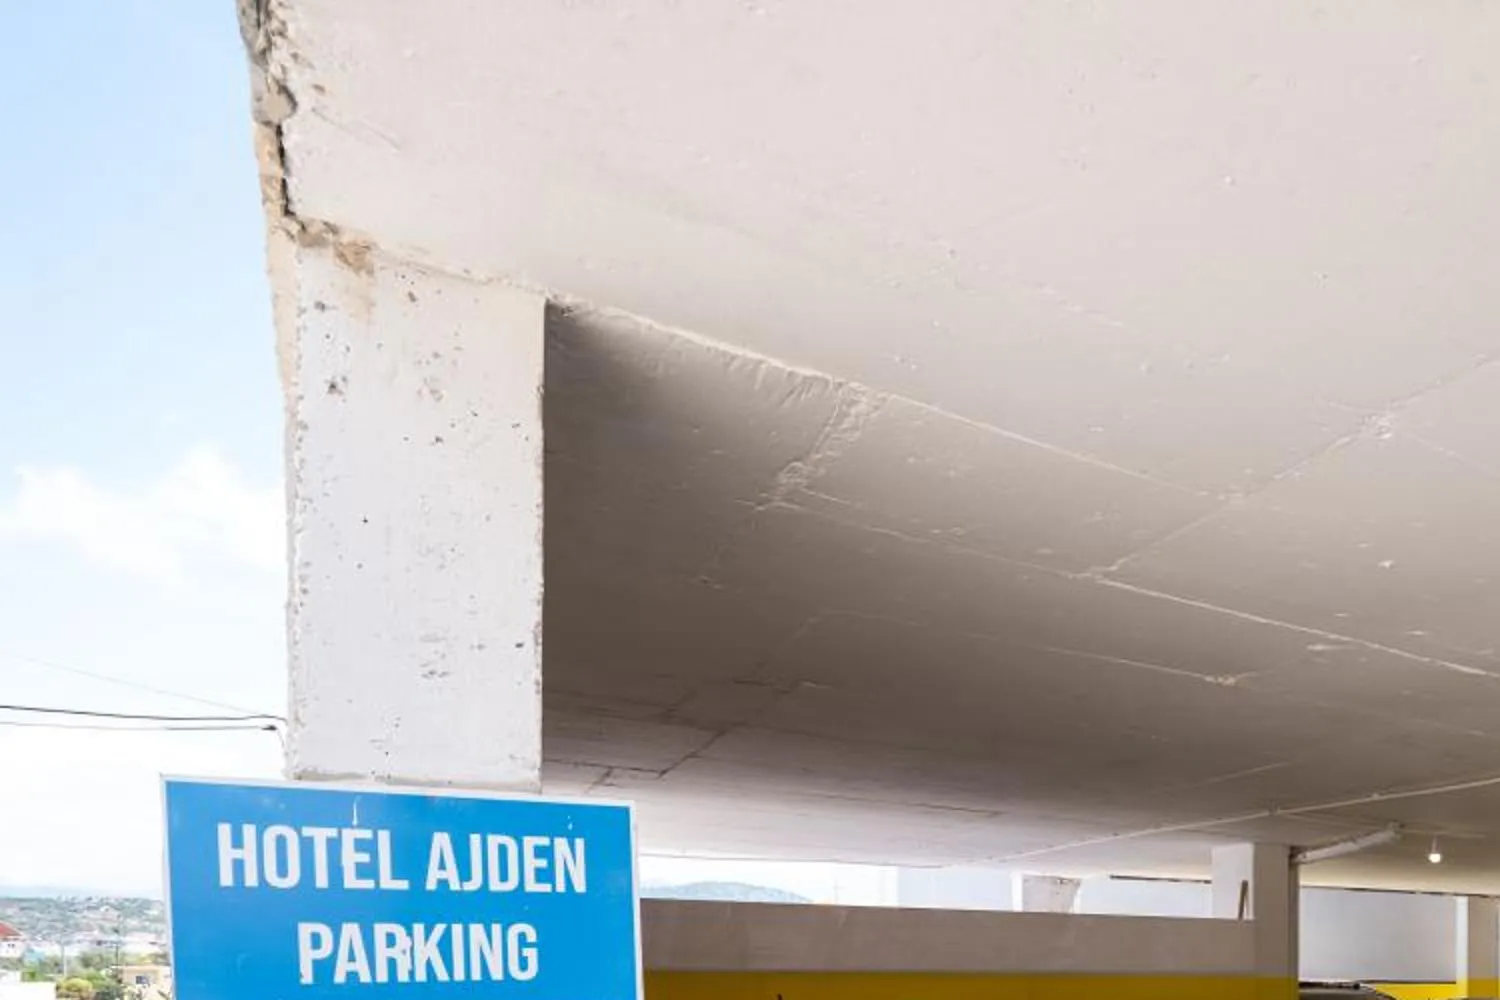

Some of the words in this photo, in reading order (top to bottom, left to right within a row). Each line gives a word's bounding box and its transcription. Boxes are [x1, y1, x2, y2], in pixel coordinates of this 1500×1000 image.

[216, 822, 410, 891] HOTEL
[425, 831, 587, 894] AJDEN
[297, 921, 539, 985] PARKING
